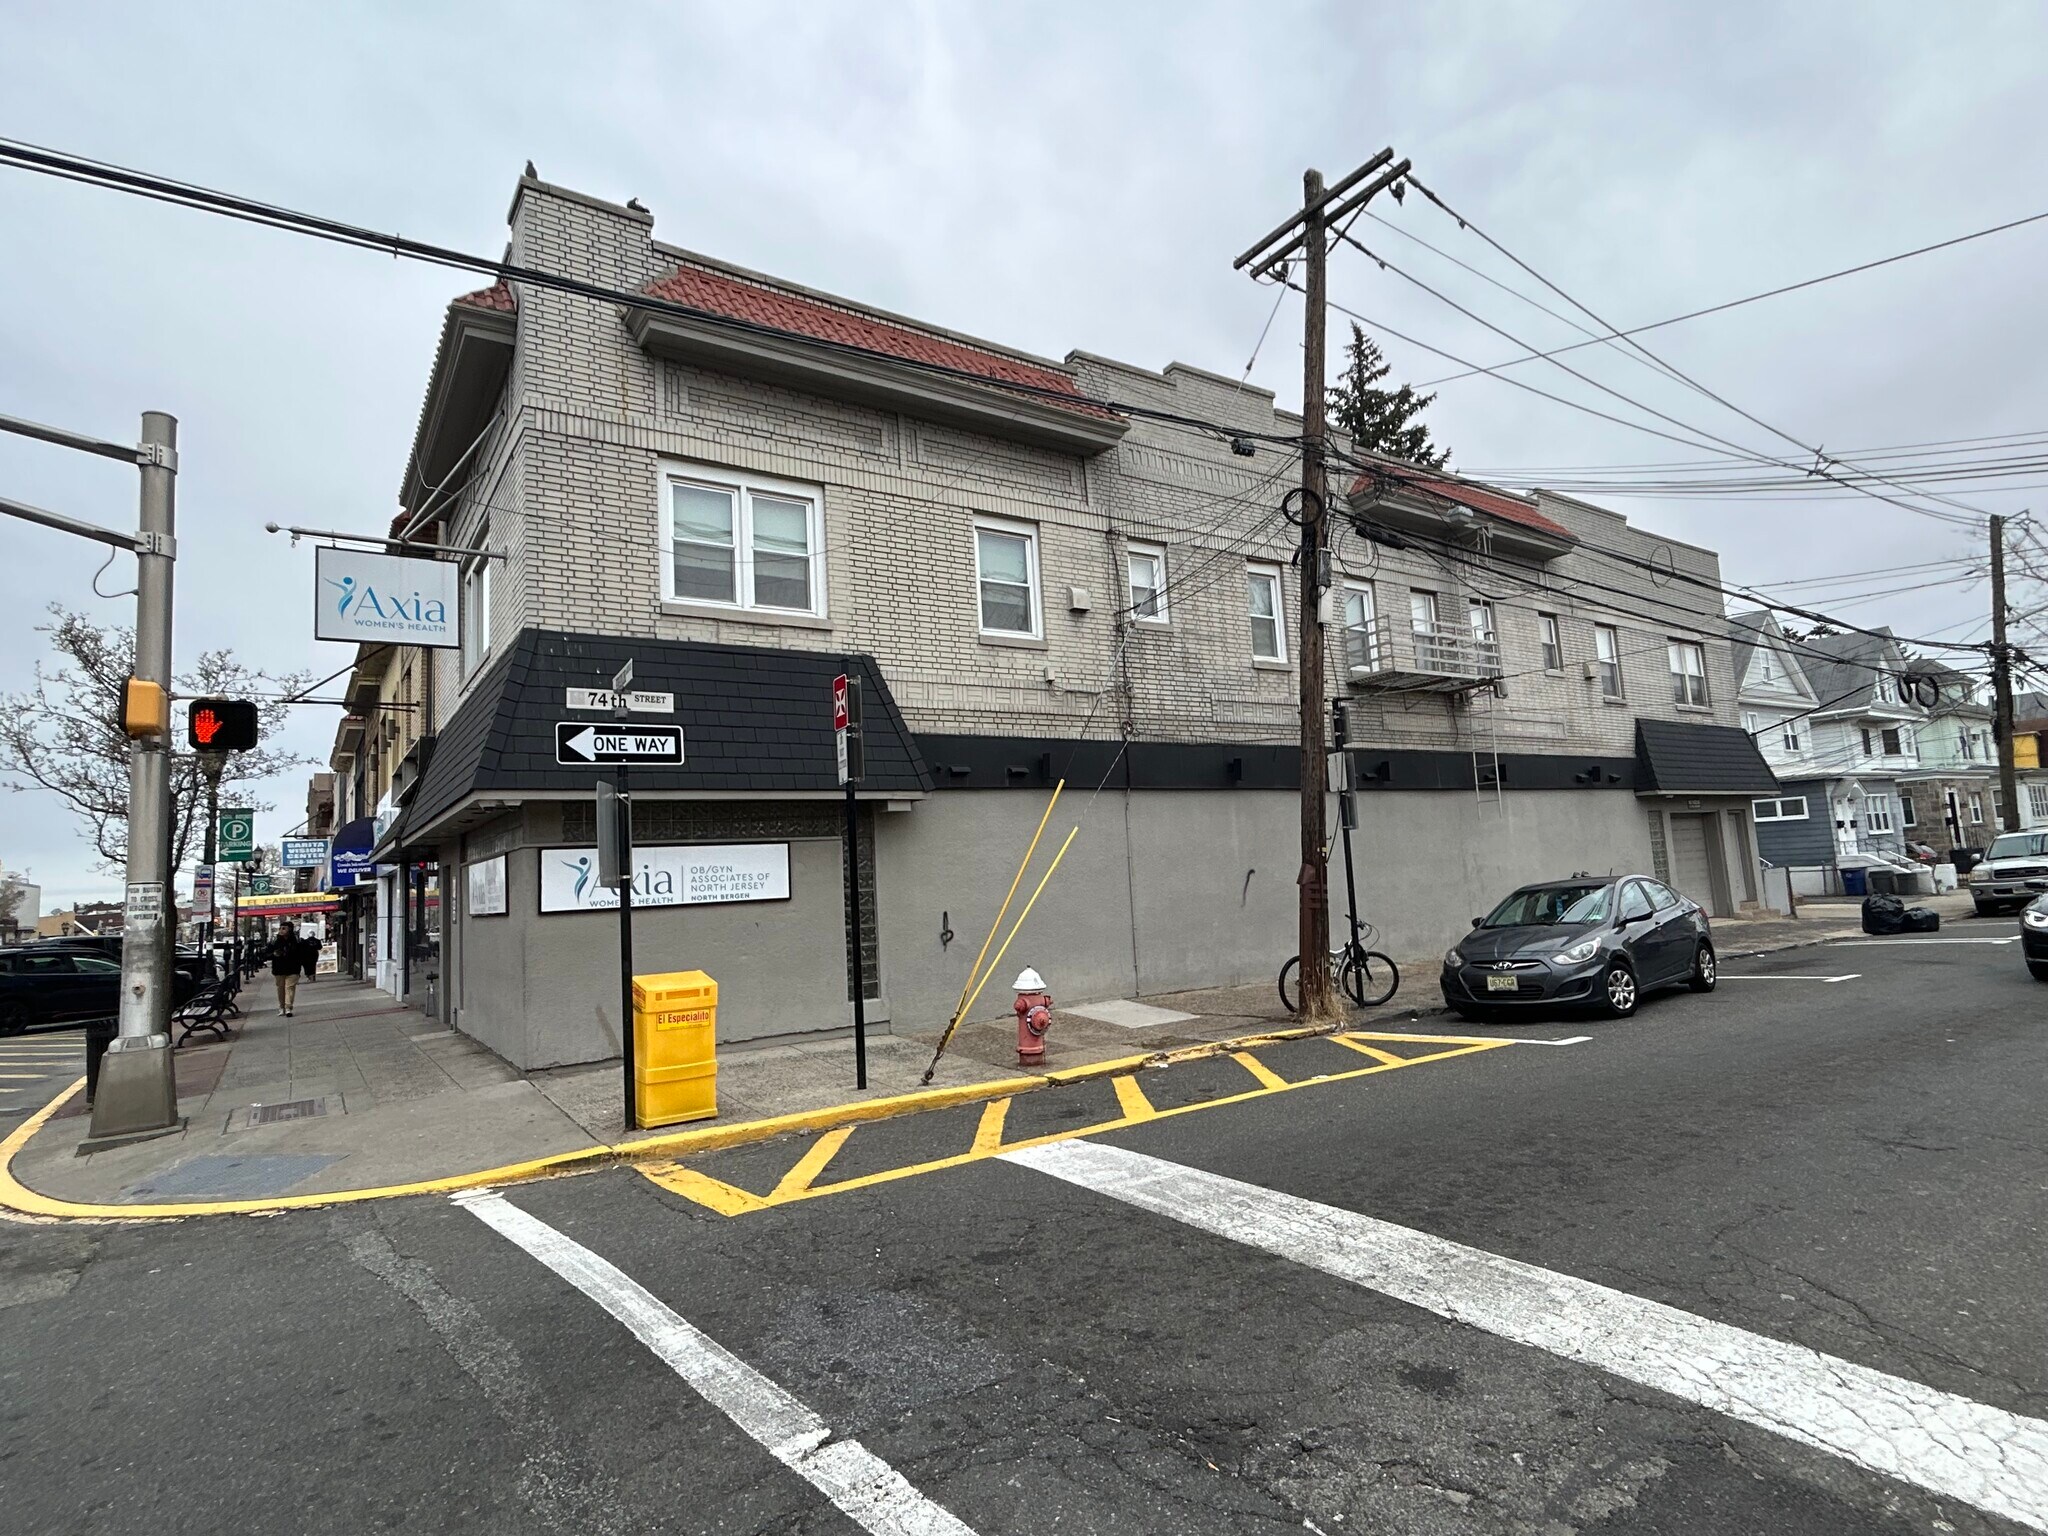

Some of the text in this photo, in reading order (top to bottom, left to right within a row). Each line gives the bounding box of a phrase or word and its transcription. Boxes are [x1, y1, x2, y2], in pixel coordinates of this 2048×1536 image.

[353, 586, 446, 623] Axia
[354, 619, 446, 632] WOMEN'S HEALTH
[634, 694, 667, 704] STREET
[593, 736, 669, 752] ONE WAY
[232, 824, 244, 838] P
[690, 865, 733, 875] OB/GYN
[690, 873, 770, 884] ASSOCIATES OF
[690, 882, 765, 893] NORTH JERSEY
[589, 897, 674, 908] WOMES HEALTH
[658, 1011, 709, 1024] El Especialito
